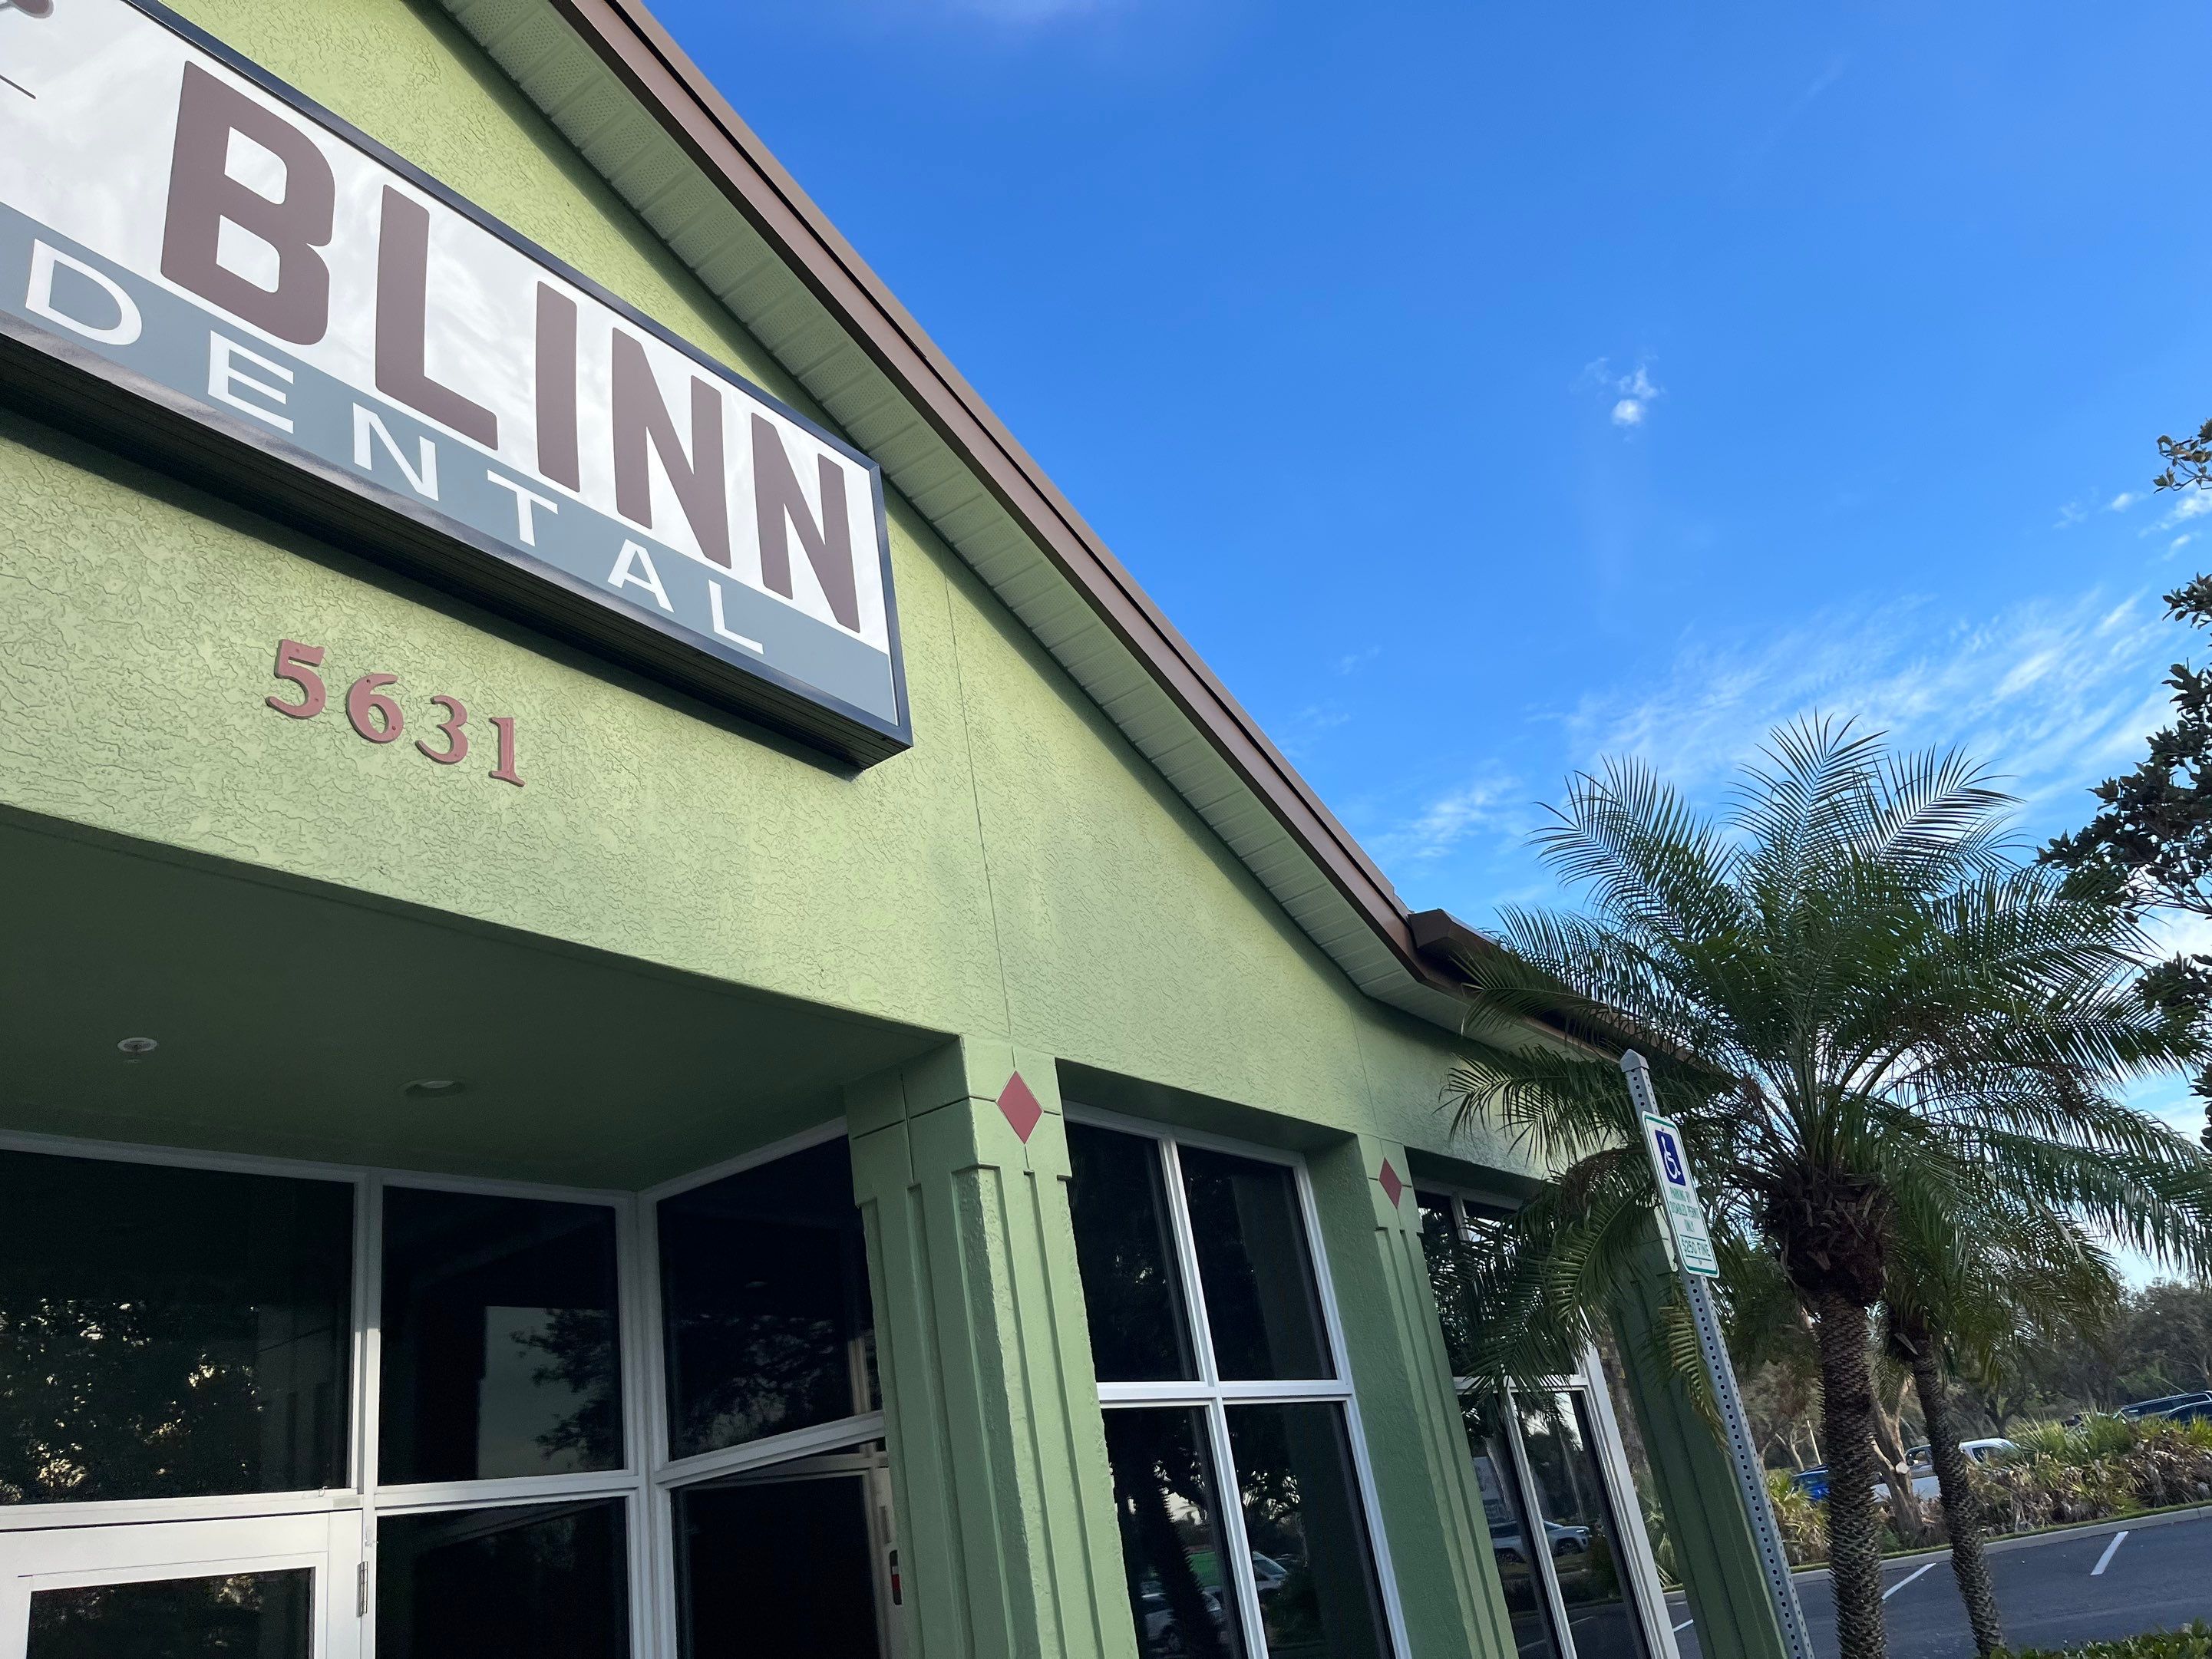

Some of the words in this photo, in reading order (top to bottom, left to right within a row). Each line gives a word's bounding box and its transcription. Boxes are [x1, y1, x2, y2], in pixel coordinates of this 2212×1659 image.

[160, 60, 860, 634] BLINN
[25, 239, 764, 655] DENTAL
[266, 638, 526, 787] 5631
[1669, 1186, 1687, 1202] PARKING
[1669, 1201, 1688, 1216] DISABLED
[1687, 1205, 1700, 1219] PERMIT
[1681, 1238, 1697, 1254] $250
[1697, 1242, 1711, 1257] FINE
